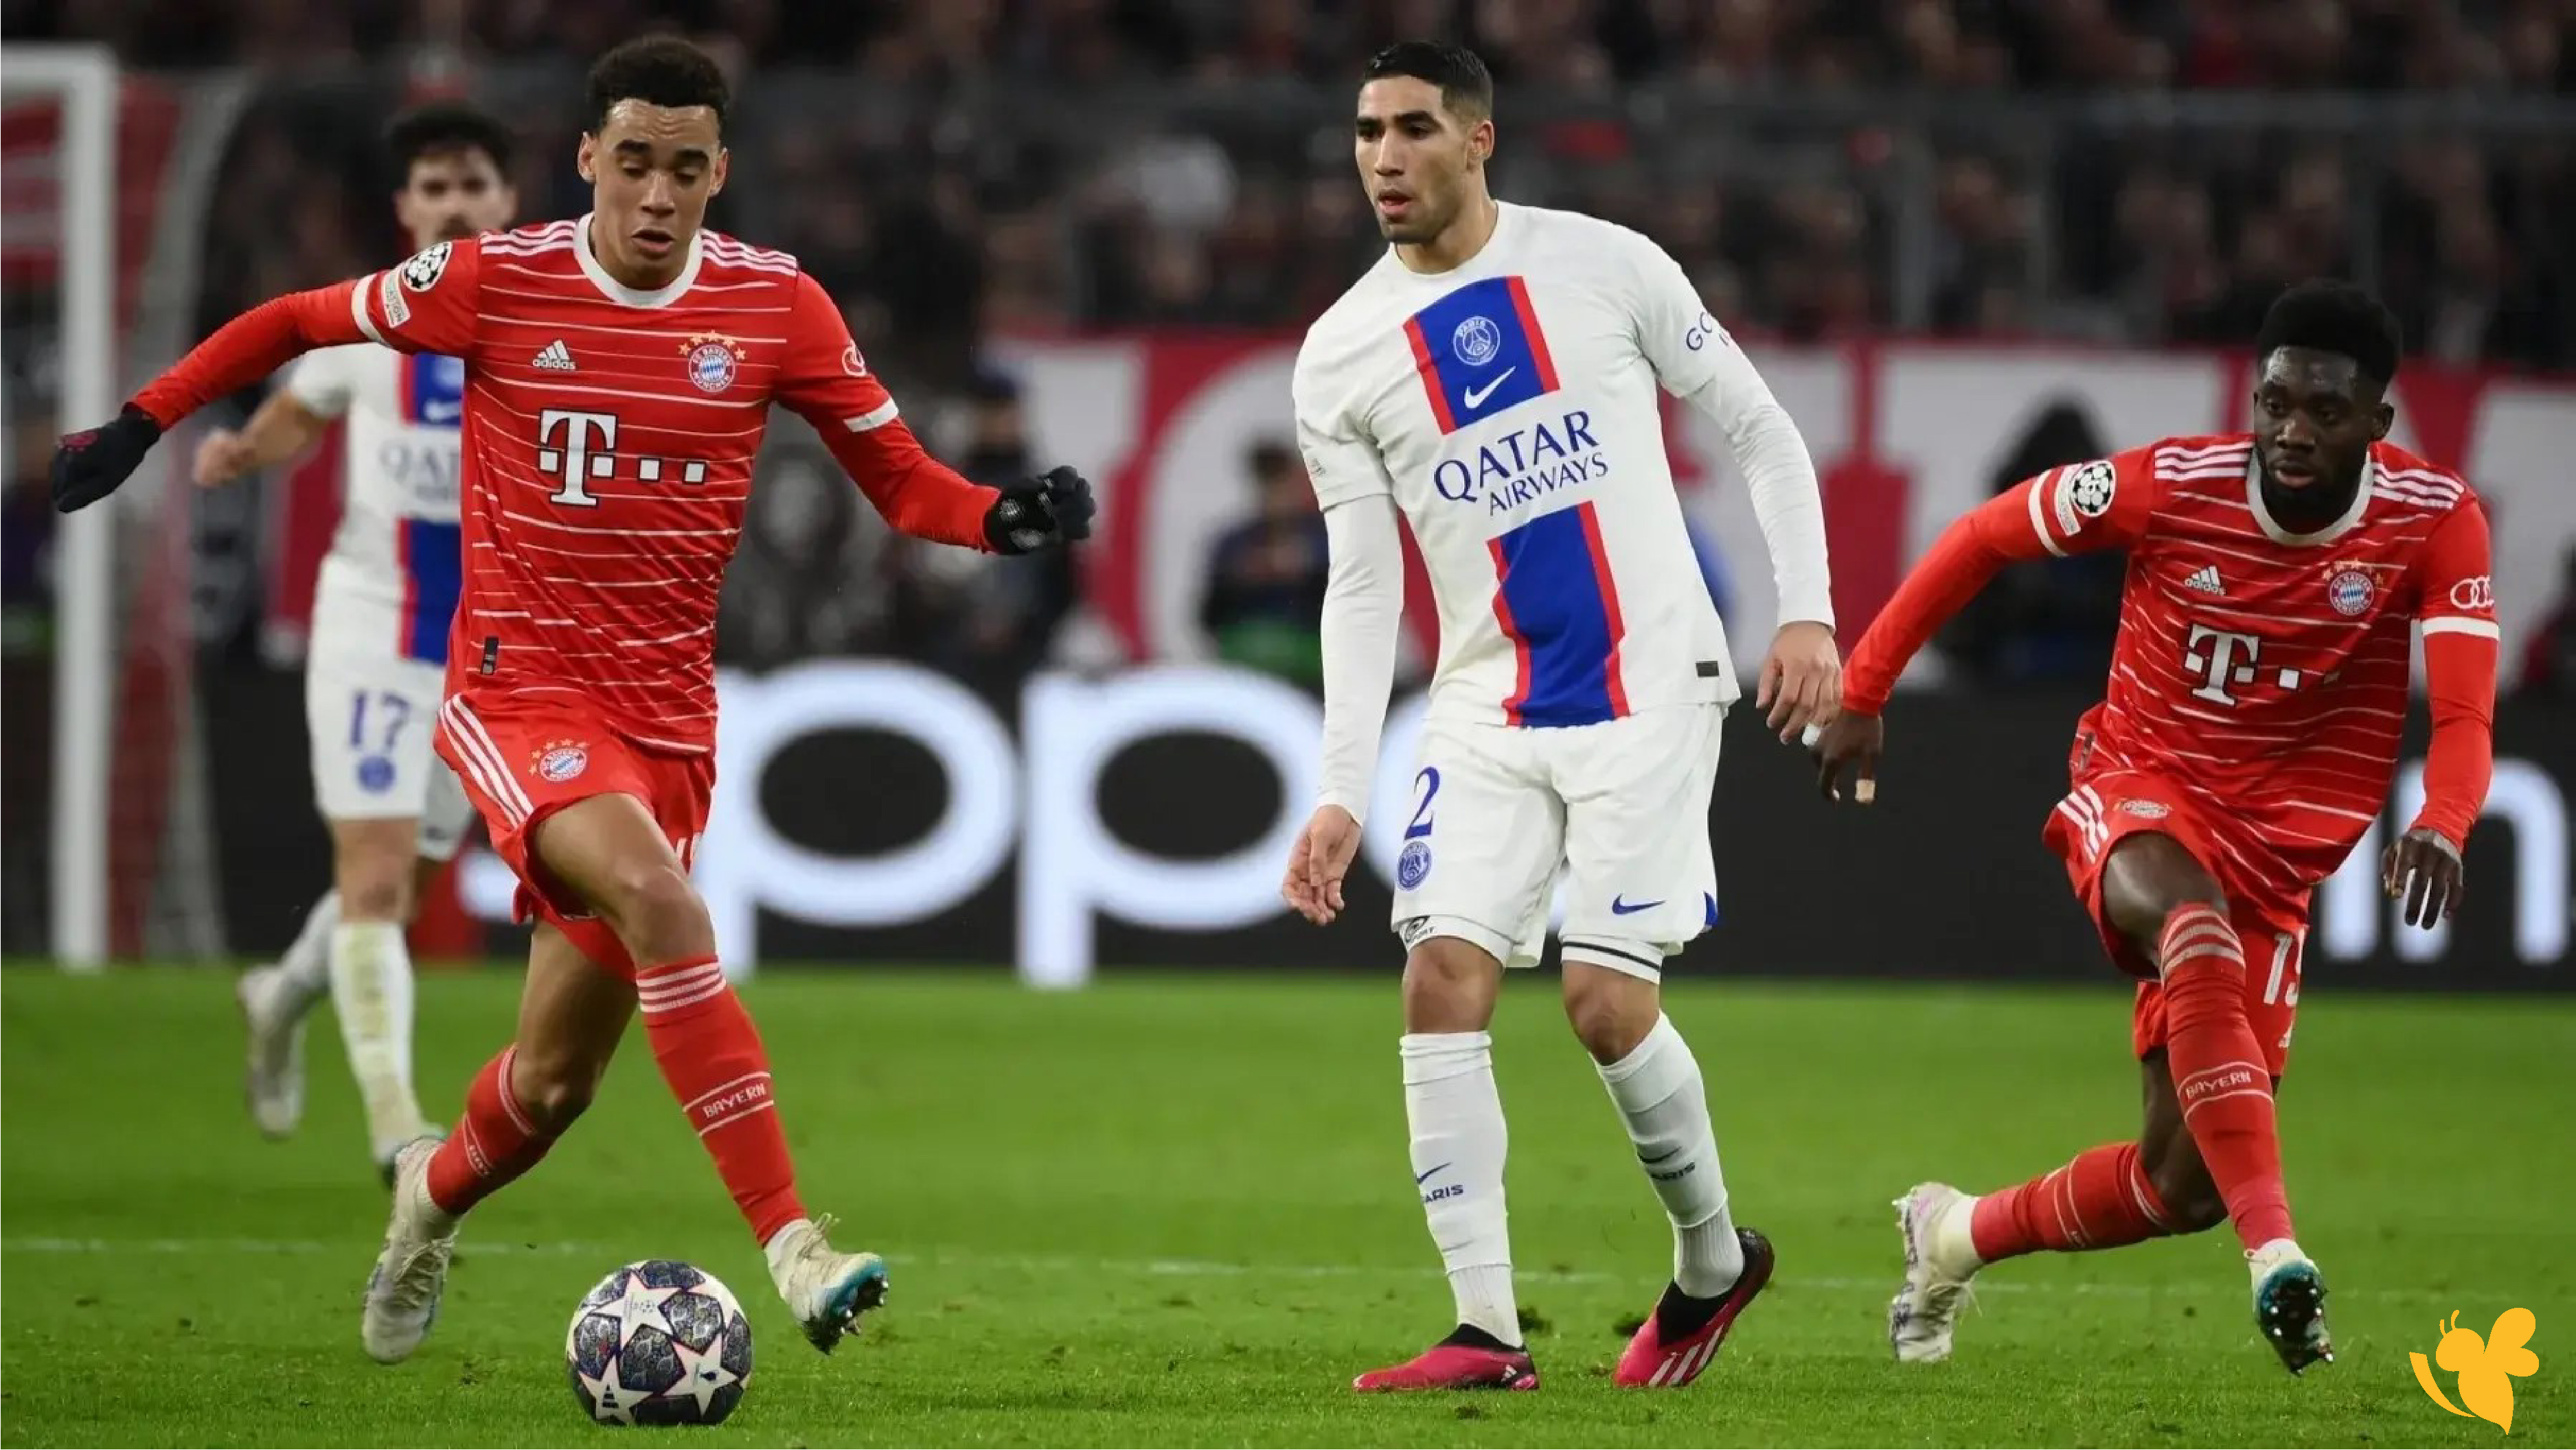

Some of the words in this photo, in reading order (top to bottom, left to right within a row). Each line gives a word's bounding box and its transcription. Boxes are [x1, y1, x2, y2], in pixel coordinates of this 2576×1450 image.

[532, 359, 576, 370] adidas
[1434, 411, 1600, 503] QATAR
[1489, 451, 1609, 517] AIRWAYS
[2185, 578, 2226, 596] adidas
[349, 690, 413, 750] 17
[1404, 765, 1441, 841] 2
[703, 1083, 767, 1119] BAYERN
[2185, 1070, 2252, 1100] BAYERN
[1424, 1184, 1463, 1203] ARIS
